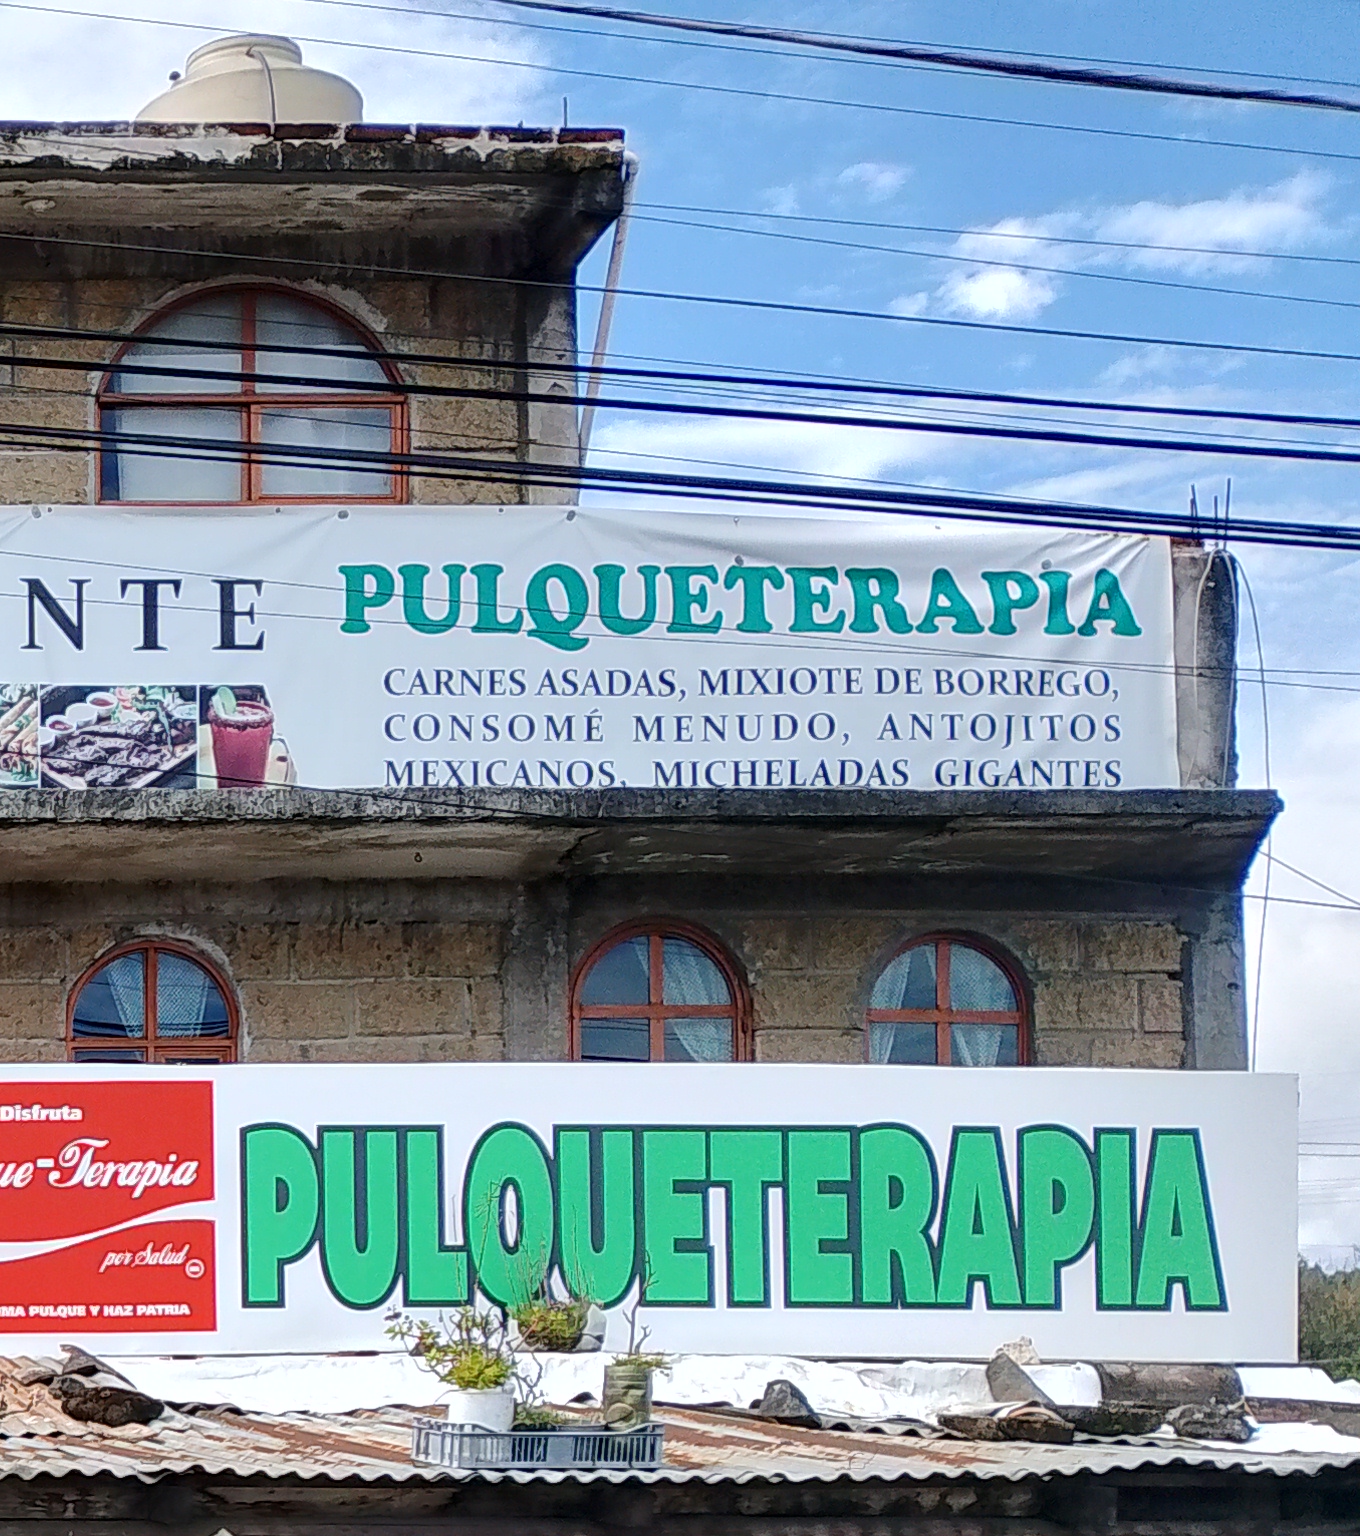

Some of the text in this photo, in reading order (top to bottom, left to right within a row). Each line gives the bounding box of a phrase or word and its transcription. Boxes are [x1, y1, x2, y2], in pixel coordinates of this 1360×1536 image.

[337, 561, 1143, 652] PULQUETERAPIA
[383, 668, 1120, 702] CARNES ASADAS, MIXIOTE DE BORREGO,
[384, 708, 1121, 749] CONSOMÉ MENUDO, ANTOJITOS
[653, 759, 909, 788] MICHELADAS
[934, 759, 1122, 788] GIGANTES
[0, 1105, 82, 1121] Disfruta
[240, 1122, 1228, 1313] PULQUETERAPIA
[98, 1241, 191, 1273] por Salud
[29, 1305, 86, 1318] PULQUE
[89, 1305, 100, 1316] Y
[103, 1304, 134, 1317] HAZ
[136, 1304, 191, 1316] PATRIA
